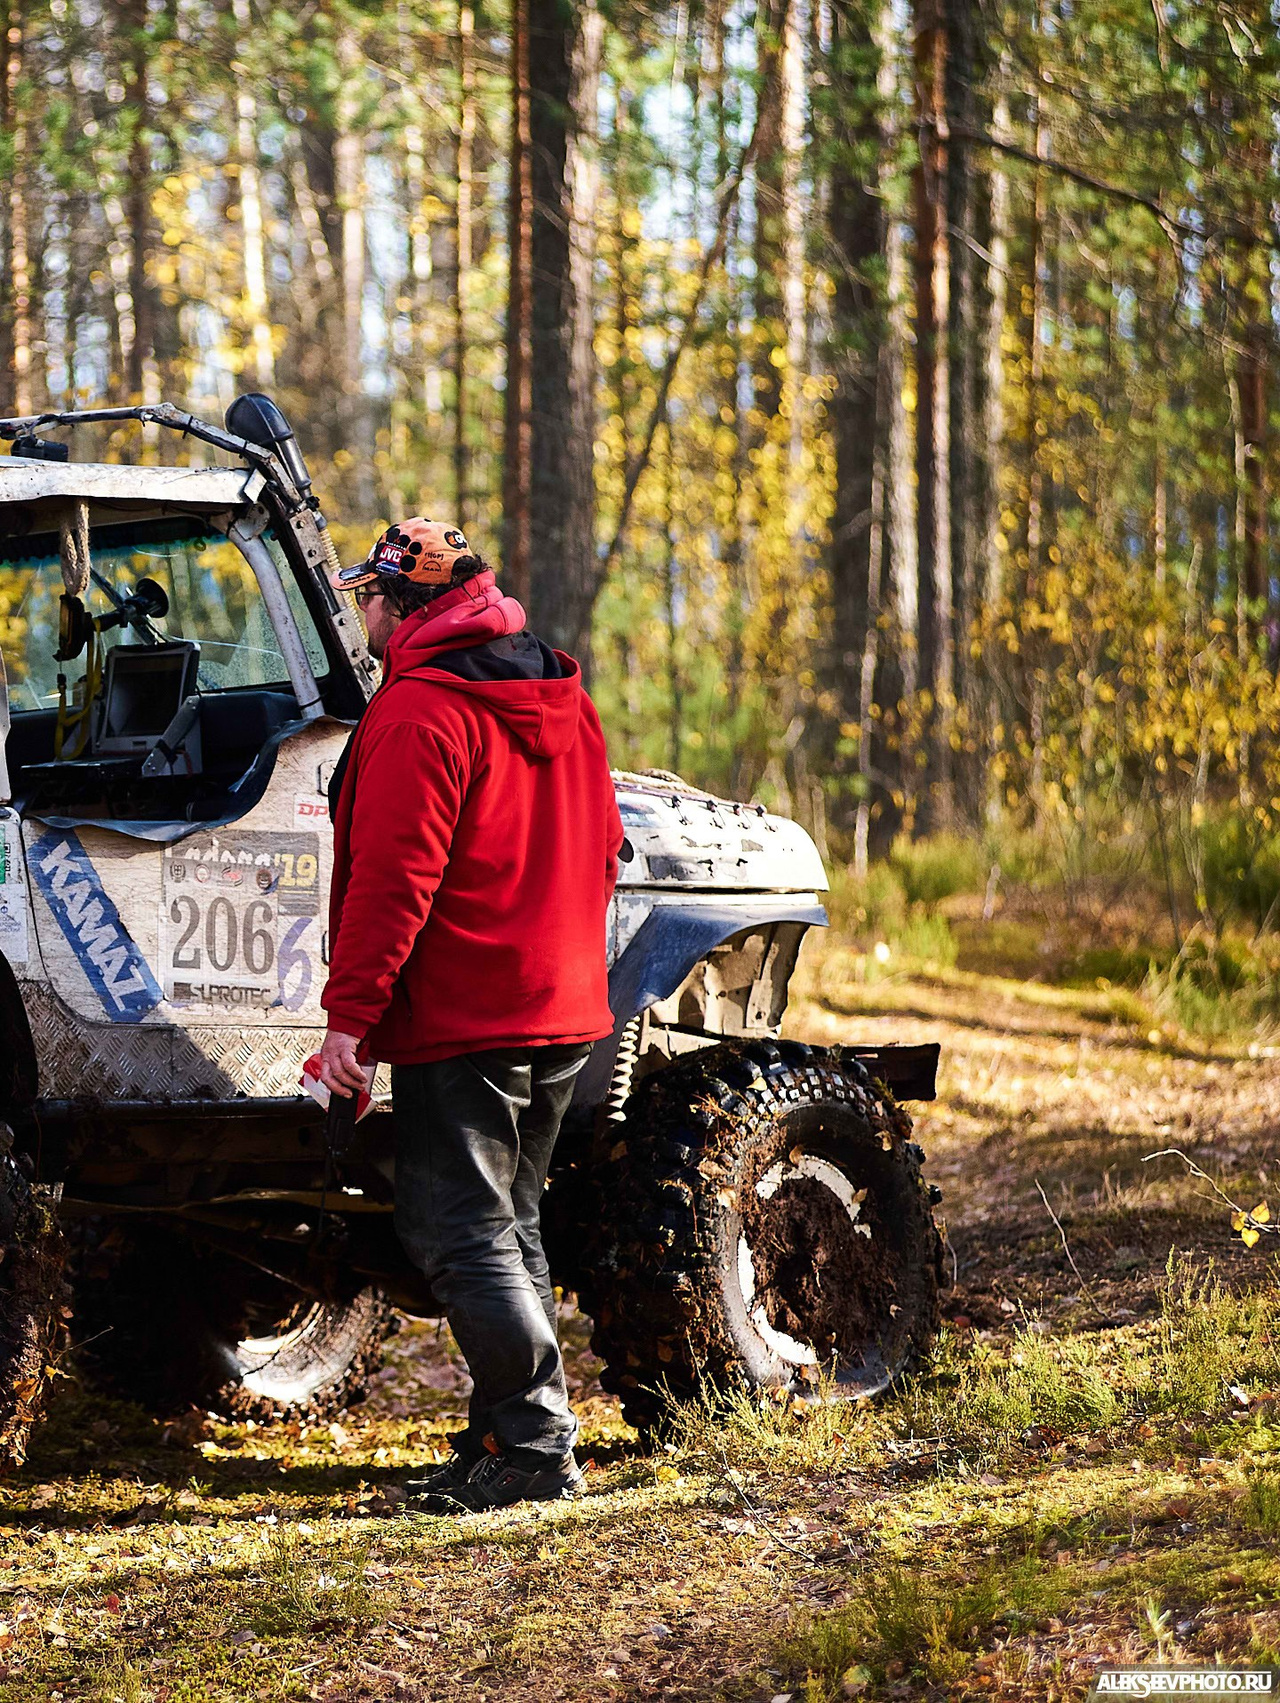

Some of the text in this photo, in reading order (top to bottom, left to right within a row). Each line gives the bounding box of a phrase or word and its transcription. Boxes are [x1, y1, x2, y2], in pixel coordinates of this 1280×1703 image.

[380, 548, 402, 562] JVC
[40, 841, 151, 1012] KAMAZ
[172, 895, 275, 975] 206
[277, 917, 312, 1012] 6
